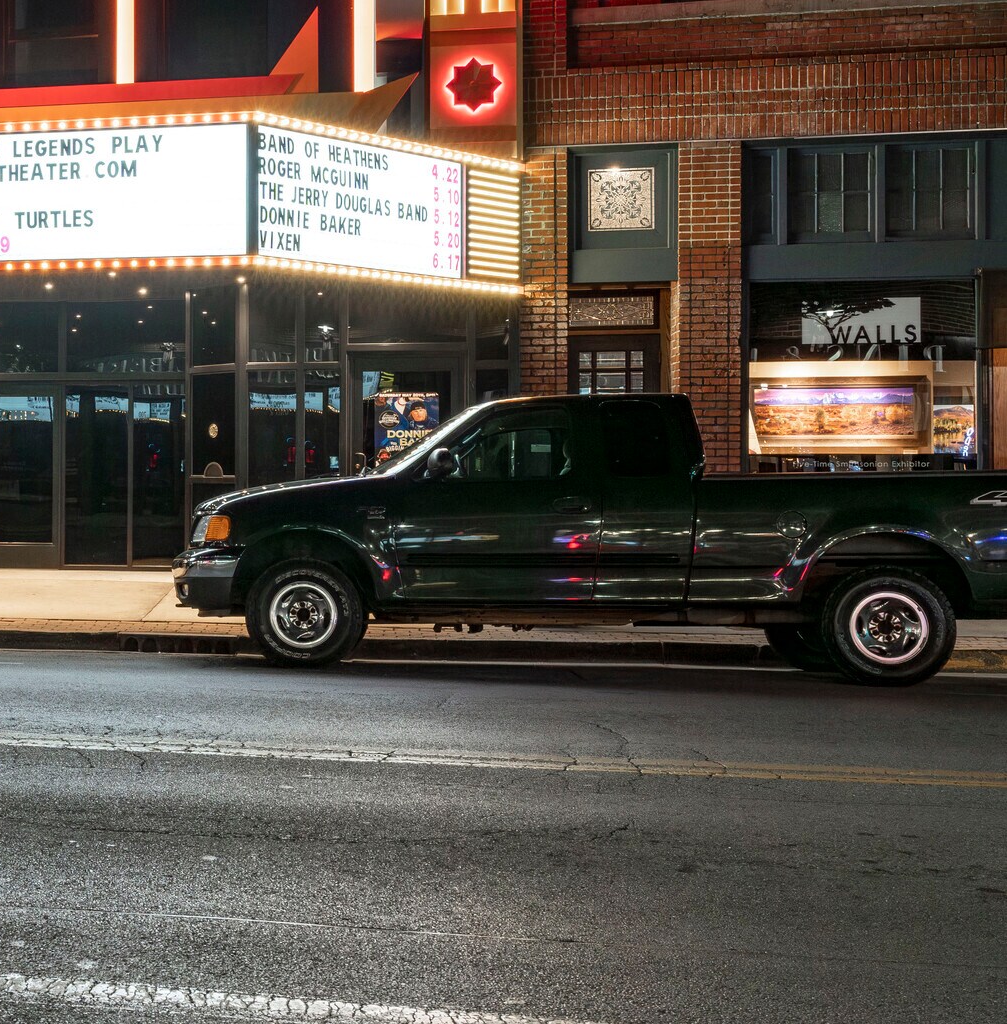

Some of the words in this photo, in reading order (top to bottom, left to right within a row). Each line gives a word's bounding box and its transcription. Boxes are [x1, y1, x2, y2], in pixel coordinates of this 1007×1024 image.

[13, 138, 95, 159] LEGENDS
[112, 134, 164, 154] PLAY
[258, 133, 294, 155] BAND
[304, 141, 319, 159] OF
[328, 144, 389, 171] HEATHENS
[431, 164, 459, 184] 4.22
[258, 158, 301, 180] ROGER
[311, 165, 369, 190] MCGUINN
[259, 181, 284, 201] THE
[291, 186, 329, 208] JERRY
[335, 193, 391, 217] DOUGLAS
[397, 204, 428, 223] BAND
[14, 209, 94, 230] TURTLES
[259, 205, 310, 230] DONNIE
[320, 214, 361, 236] BAKER
[259, 230, 301, 252] VIXEN
[432, 252, 460, 271] 6.17
[830, 324, 918, 343] WALLS
[835, 460, 889, 469] Smisonian
[891, 459, 931, 469] Exhibitor
